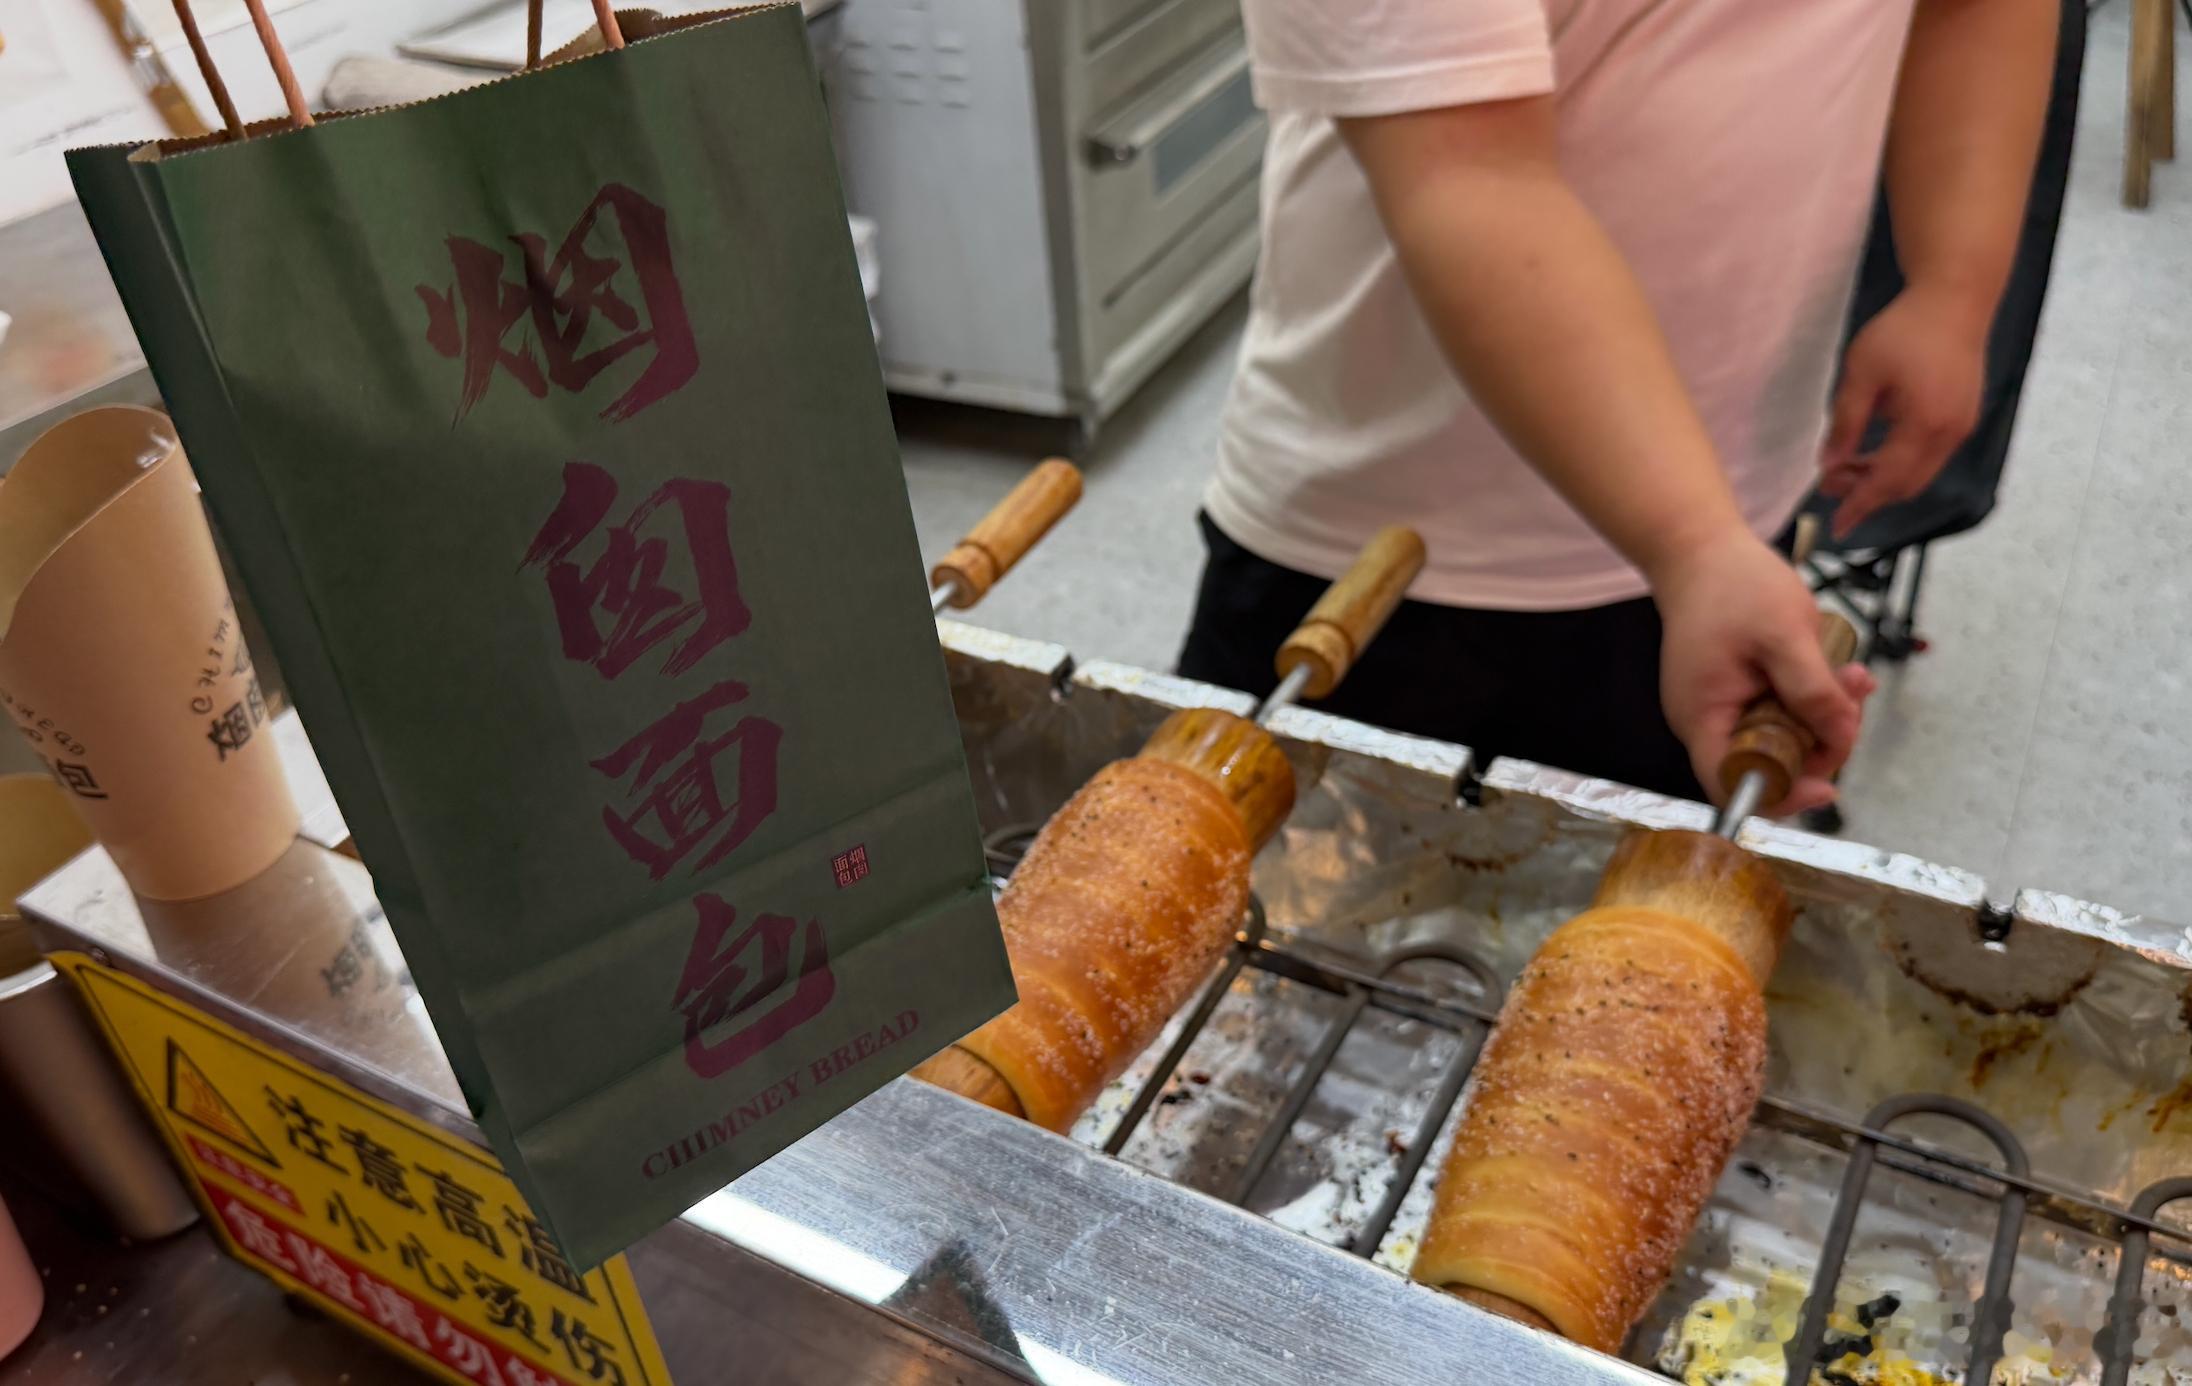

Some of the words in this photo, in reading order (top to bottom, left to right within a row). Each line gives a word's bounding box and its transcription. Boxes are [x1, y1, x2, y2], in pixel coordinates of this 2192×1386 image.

[641, 1068, 802, 1181] CHIMNEY
[807, 1008, 920, 1086] BREAD
[264, 1084, 599, 1306] 注意高温
[326, 1190, 626, 1386] 小心烫伤
